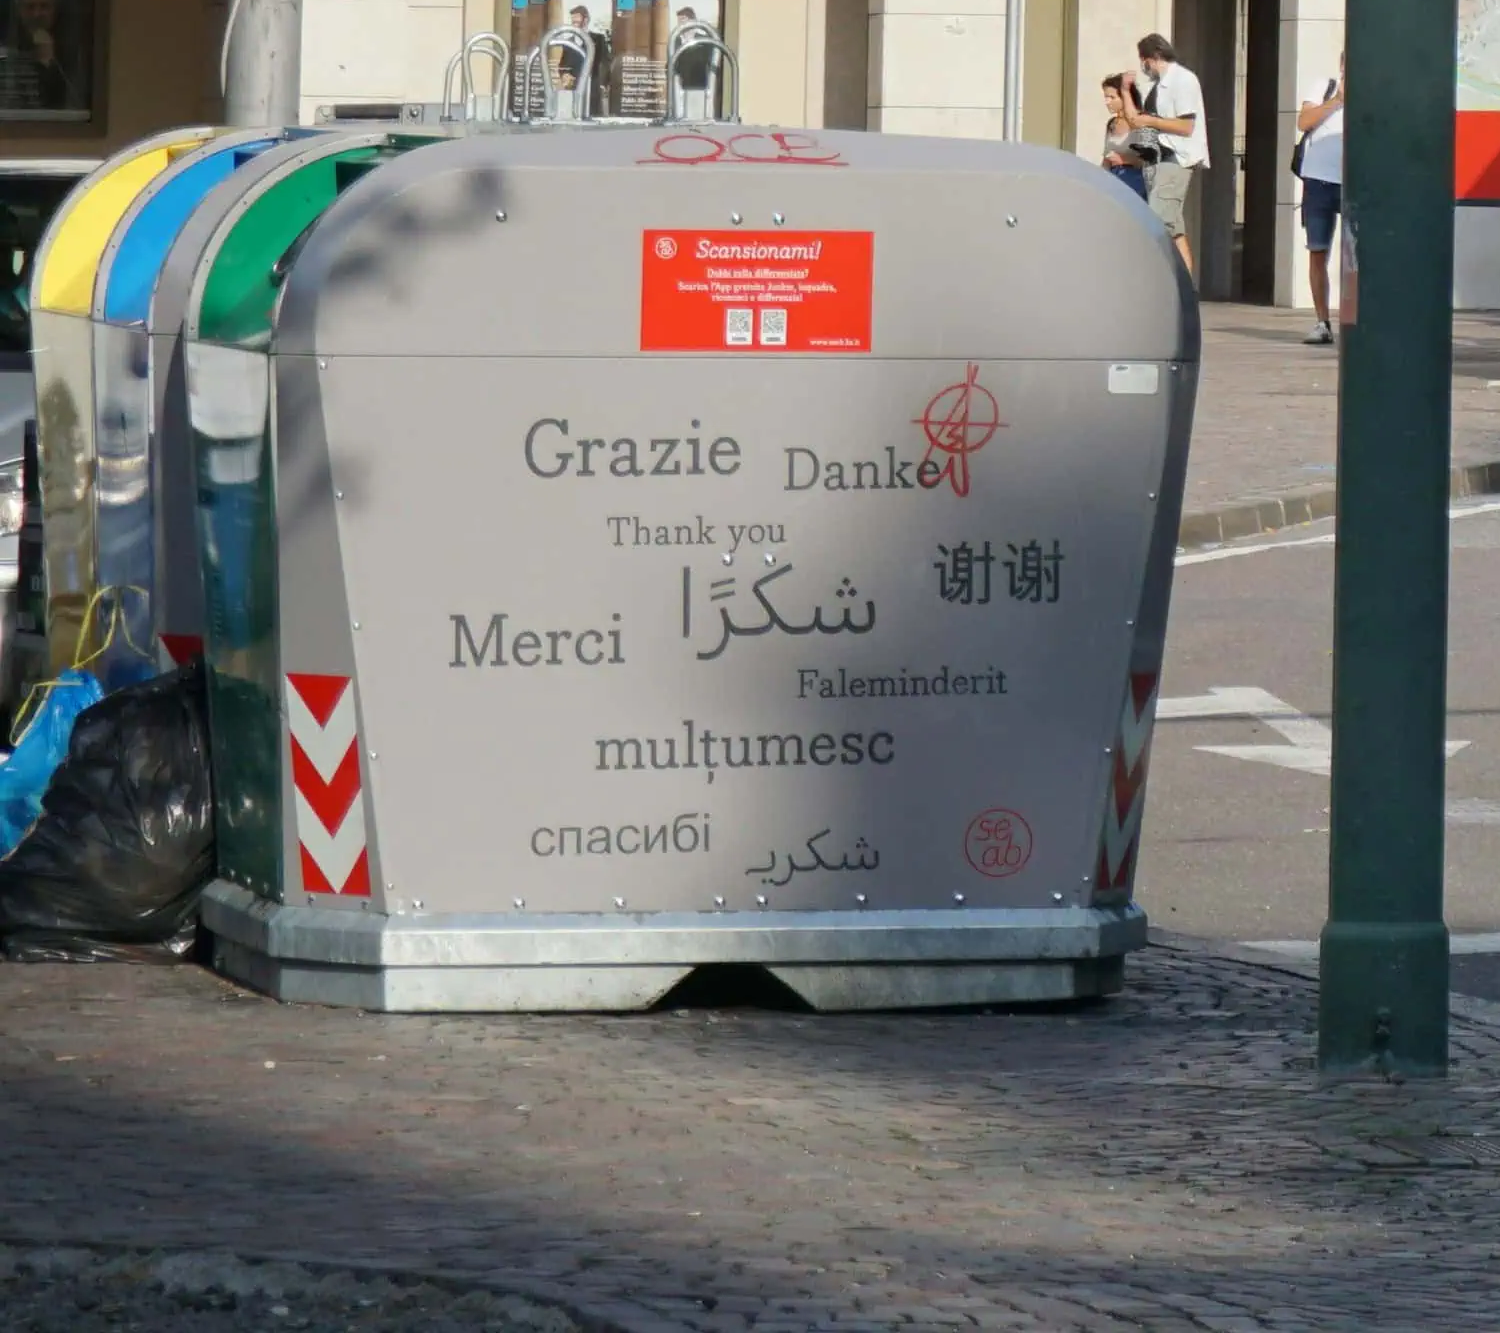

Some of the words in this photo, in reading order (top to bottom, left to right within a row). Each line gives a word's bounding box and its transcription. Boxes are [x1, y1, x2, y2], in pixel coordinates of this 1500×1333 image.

[696, 240, 822, 260] Scansionami!
[524, 417, 742, 478] Grazie
[783, 446, 941, 491] Danke
[606, 516, 716, 546] Thank
[728, 522, 787, 553] you
[933, 539, 1064, 605] 谢谢
[448, 612, 626, 668] Merci
[796, 665, 1008, 700] Faleminderit
[530, 812, 712, 857] спасибі
